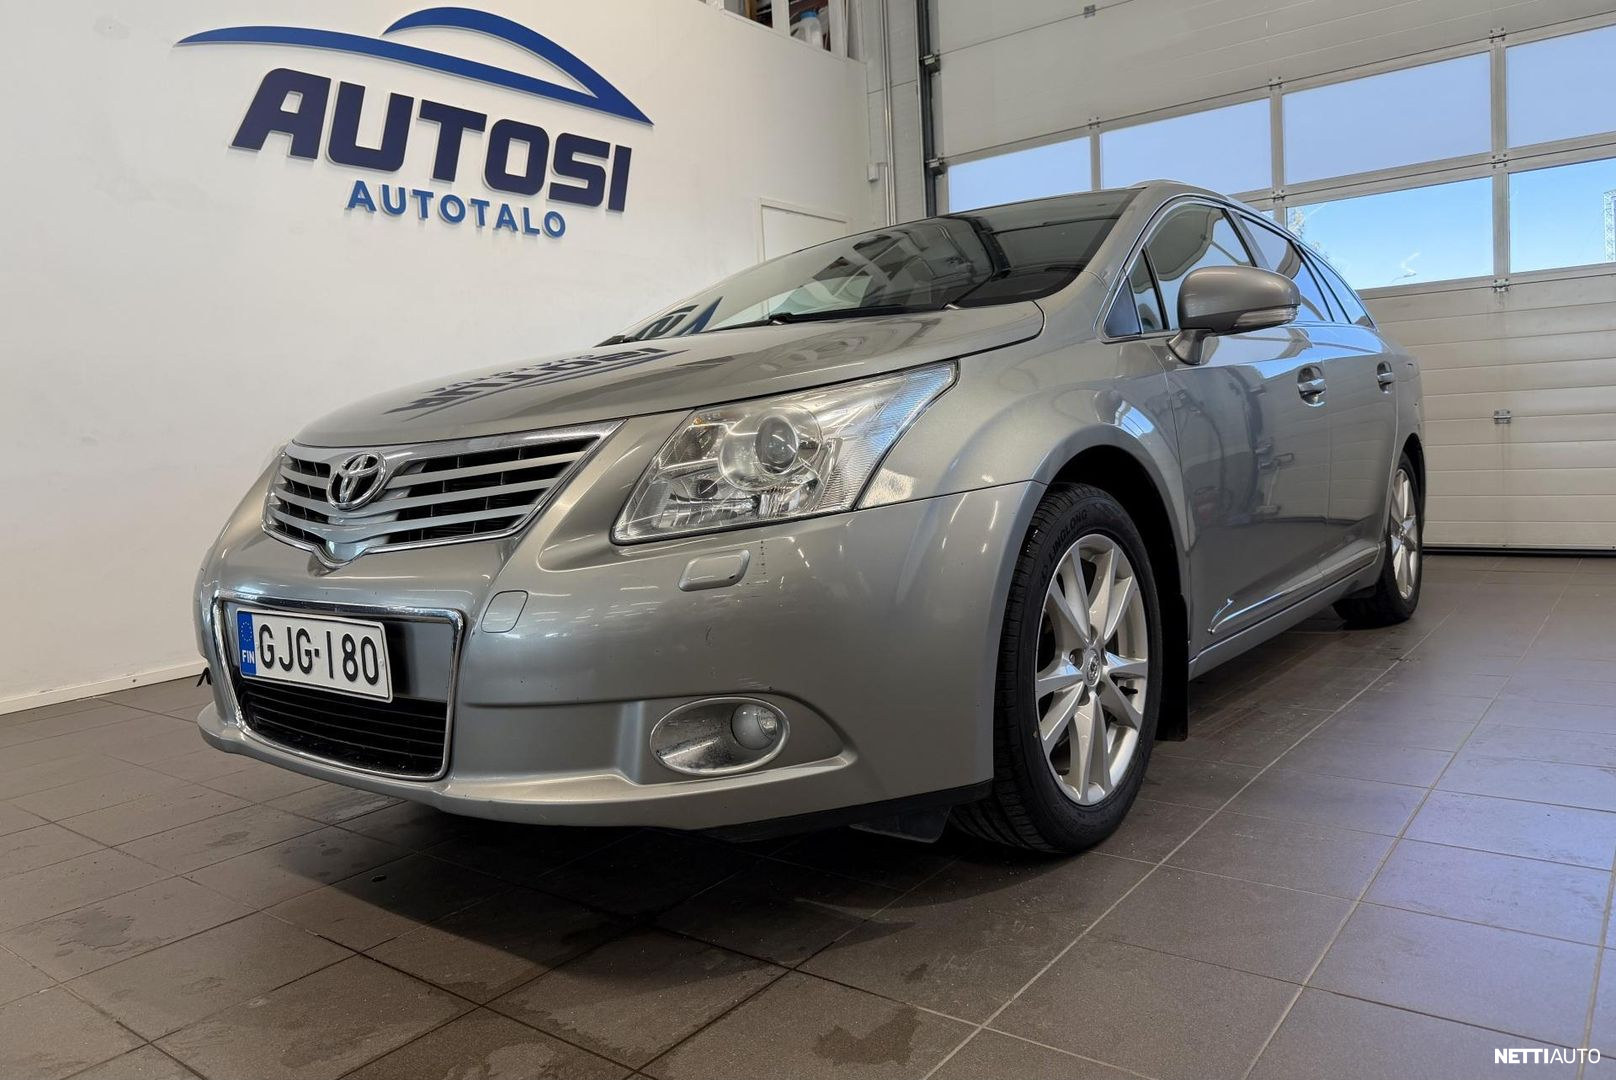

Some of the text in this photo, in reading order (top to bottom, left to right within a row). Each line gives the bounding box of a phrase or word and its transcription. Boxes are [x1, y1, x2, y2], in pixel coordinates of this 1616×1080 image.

[229, 67, 632, 213] AUTOSI
[346, 180, 566, 239] AUTOTALO
[1048, 508, 1088, 563] LINGLONG
[241, 649, 255, 664] FIN
[258, 623, 380, 686] GJG-180
